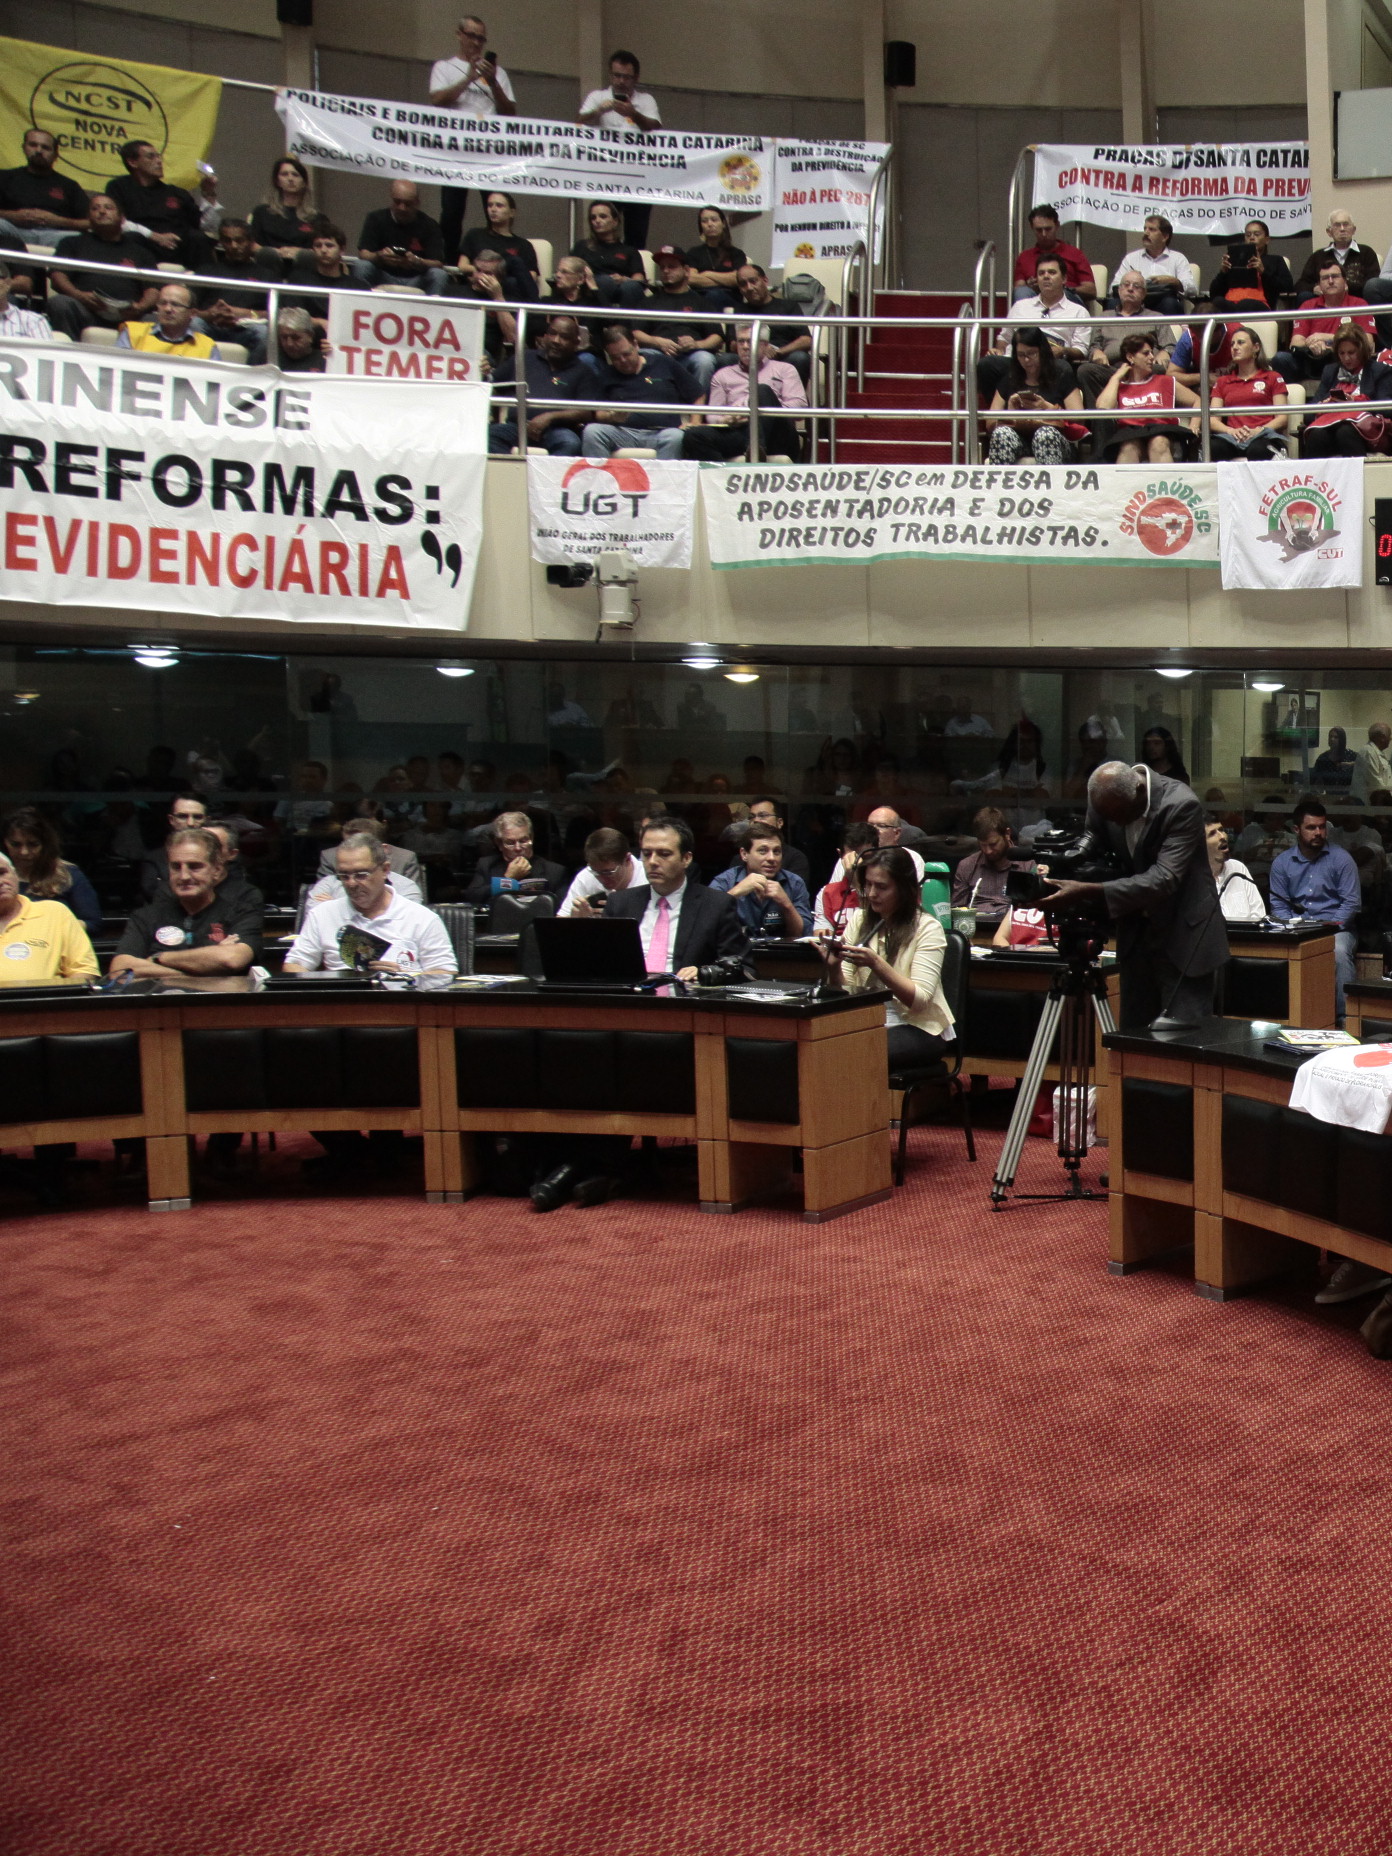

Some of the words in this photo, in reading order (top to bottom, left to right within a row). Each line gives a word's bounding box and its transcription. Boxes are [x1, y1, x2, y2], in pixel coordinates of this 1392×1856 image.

[65, 90, 136, 112] NCST
[74, 118, 128, 139] NOVA
[286, 89, 376, 117] POLICIAIS
[381, 107, 391, 120] E
[395, 109, 500, 133] BOMBEIROS
[506, 122, 595, 139] MILITARES
[600, 129, 620, 144] DE
[624, 132, 677, 148] SANTA
[682, 136, 764, 152] CATARINA
[371, 126, 444, 150] CONTRA
[447, 134, 459, 150] A
[463, 137, 544, 157] REFORMA
[549, 143, 572, 159] DA
[576, 146, 687, 169] PREVIDÊNCIA
[777, 147, 813, 158] CONTRA
[824, 148, 884, 163] DESTRUIÇÃO
[1093, 148, 1168, 168] PRAÇAS
[1193, 149, 1251, 168] SANTA
[290, 143, 386, 167] ASSOCIAÇÃO
[390, 158, 410, 172] DE
[414, 165, 473, 181] PRAÇAS
[478, 173, 498, 184] DO
[502, 174, 559, 188] ESTADO
[563, 179, 582, 190] DE
[586, 182, 633, 196] SANTA
[636, 187, 705, 200] CATARINA
[791, 161, 803, 172] DA
[1058, 168, 1127, 192] CONTRA
[1131, 174, 1143, 194] A
[1148, 176, 1229, 198] REFORMA
[1233, 175, 1258, 197] DA
[719, 193, 762, 205] APRASC
[782, 188, 807, 205] NÃO
[809, 187, 817, 204] À
[820, 189, 842, 203] PEC
[845, 191, 871, 206] 287
[1048, 195, 1120, 212] SSOCIAÇÃO
[1123, 204, 1140, 215] DE
[1143, 206, 1193, 219] PRAÇAS
[1197, 208, 1216, 219] DO
[1219, 206, 1266, 219] ESTADO
[1269, 209, 1286, 219] DE
[774, 223, 789, 232] POR
[790, 222, 817, 232] NENHUM
[819, 221, 845, 231] DIREITO
[352, 310, 461, 353] FORA
[339, 345, 471, 381] TEMER
[1121, 392, 1160, 406] CUT
[0, 433, 440, 526] REFORMAS:
[725, 467, 910, 495] SINDSAÚDE/SC
[914, 472, 945, 487] em
[950, 469, 1051, 490] DEFESA
[1063, 469, 1100, 491] DA
[561, 491, 649, 519] UGT
[1258, 474, 1342, 517] FETRAF-SUL
[1271, 490, 1307, 519] AGRICULTURA
[1308, 493, 1330, 514] FAMILIAR
[736, 496, 956, 522] APOSENTADORIA
[968, 497, 985, 517] E
[996, 497, 1053, 519] DOS
[561, 531, 588, 540] GERAL
[589, 532, 607, 541] DOS
[608, 532, 675, 543] TRABALHADORES
[758, 525, 876, 550] DIREITOS
[890, 522, 1110, 548] TRABALHISTAS.
[563, 544, 575, 553] DE
[576, 545, 602, 554] SANTA
[1318, 548, 1343, 559] CUT
